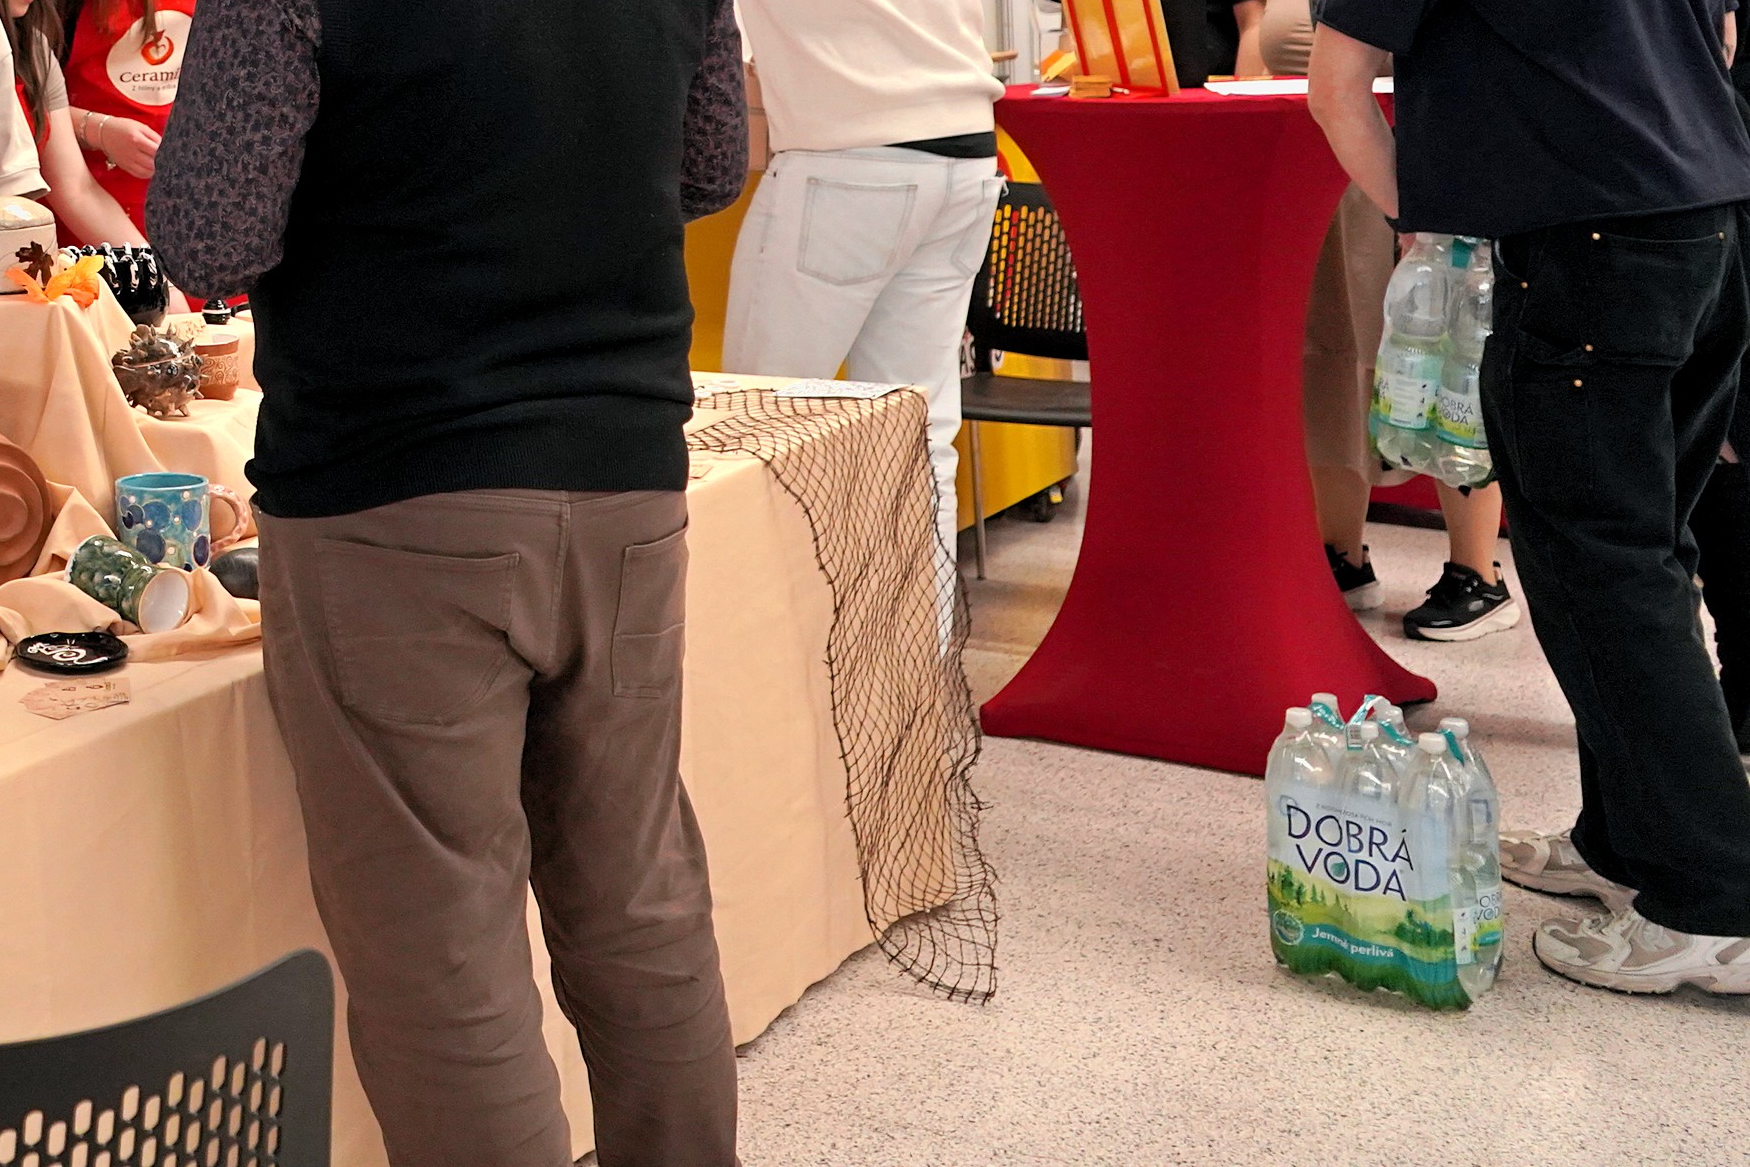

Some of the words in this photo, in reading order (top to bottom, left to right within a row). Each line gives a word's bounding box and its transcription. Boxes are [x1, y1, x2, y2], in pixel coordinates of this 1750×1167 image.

[119, 67, 181, 83] Cerami
[1286, 804, 1414, 871] DOBRÁ
[1295, 843, 1406, 902] VODA
